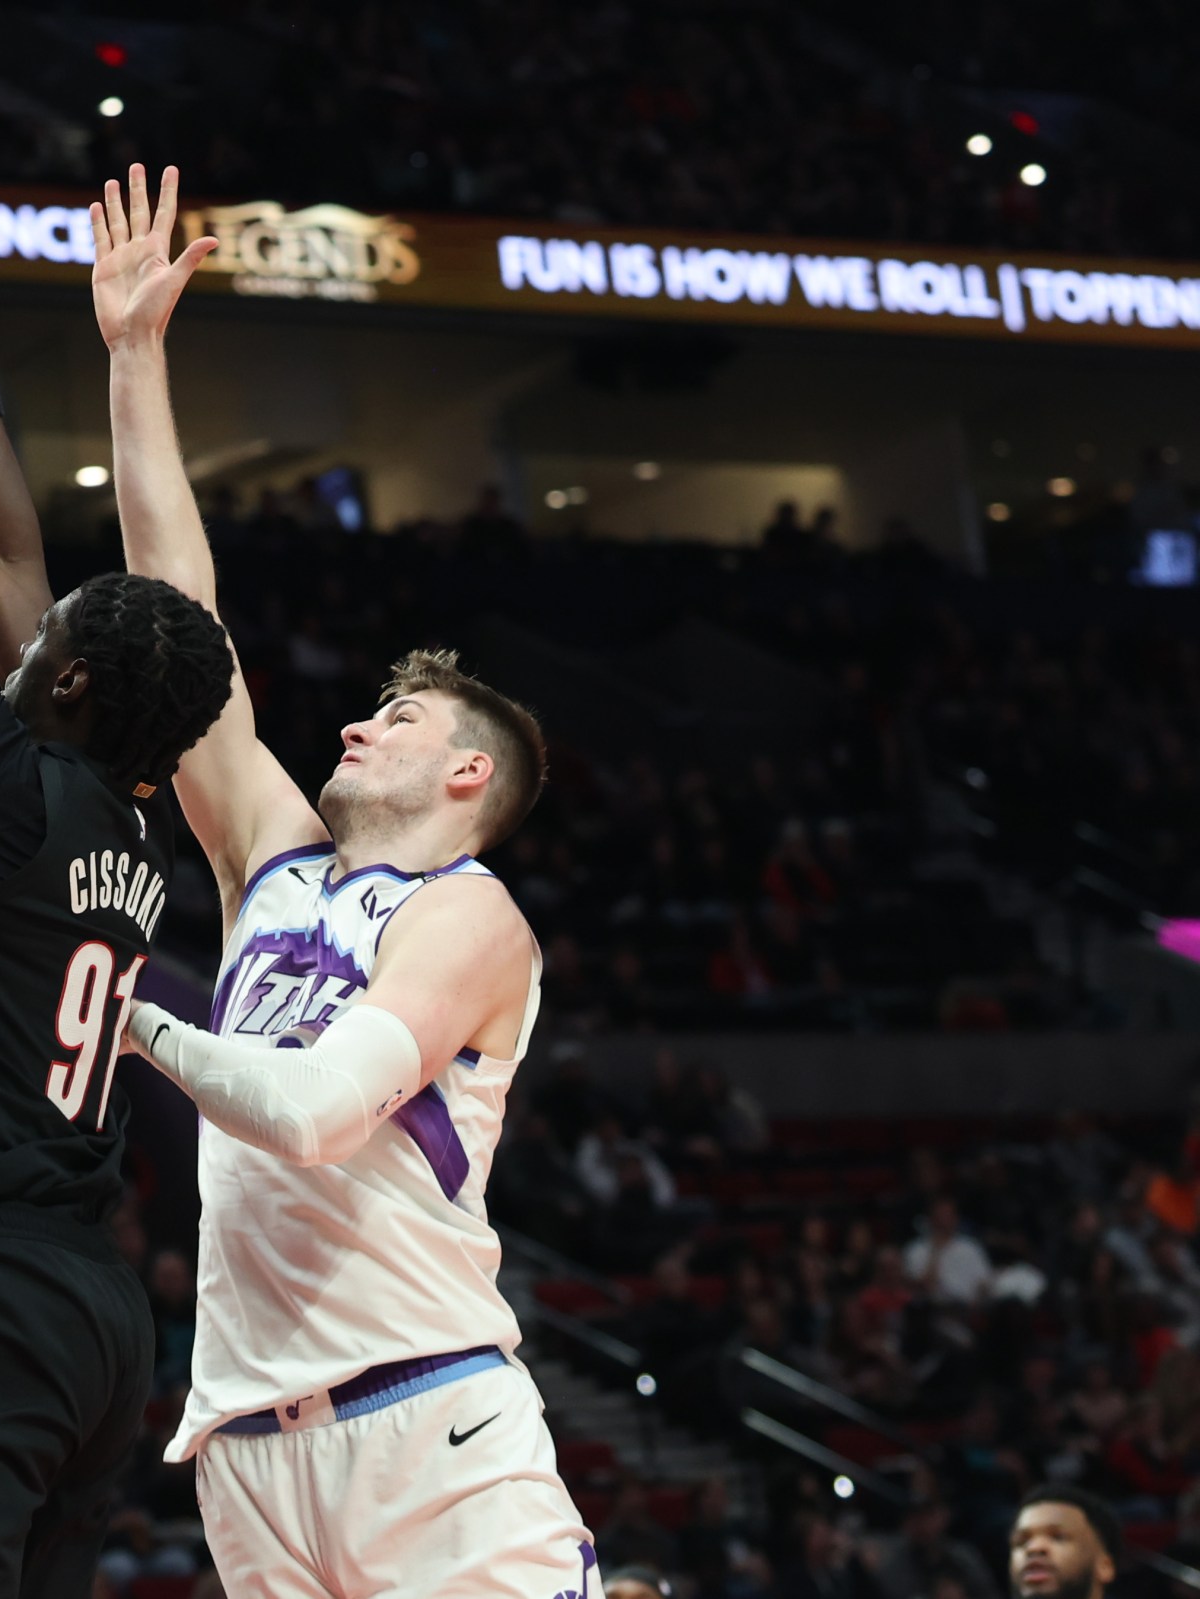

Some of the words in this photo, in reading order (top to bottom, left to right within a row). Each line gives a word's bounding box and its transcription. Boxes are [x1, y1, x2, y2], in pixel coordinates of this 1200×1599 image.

[182, 202, 420, 285] LEGENDS
[497, 235, 608, 294] FUN
[609, 243, 661, 298] IS
[661, 245, 791, 305] HOW
[793, 253, 878, 311] WE
[877, 258, 999, 318] ROLL
[69, 849, 166, 943] CISSOKO
[45, 940, 148, 1132] 91
[219, 951, 368, 1040] UTAH
